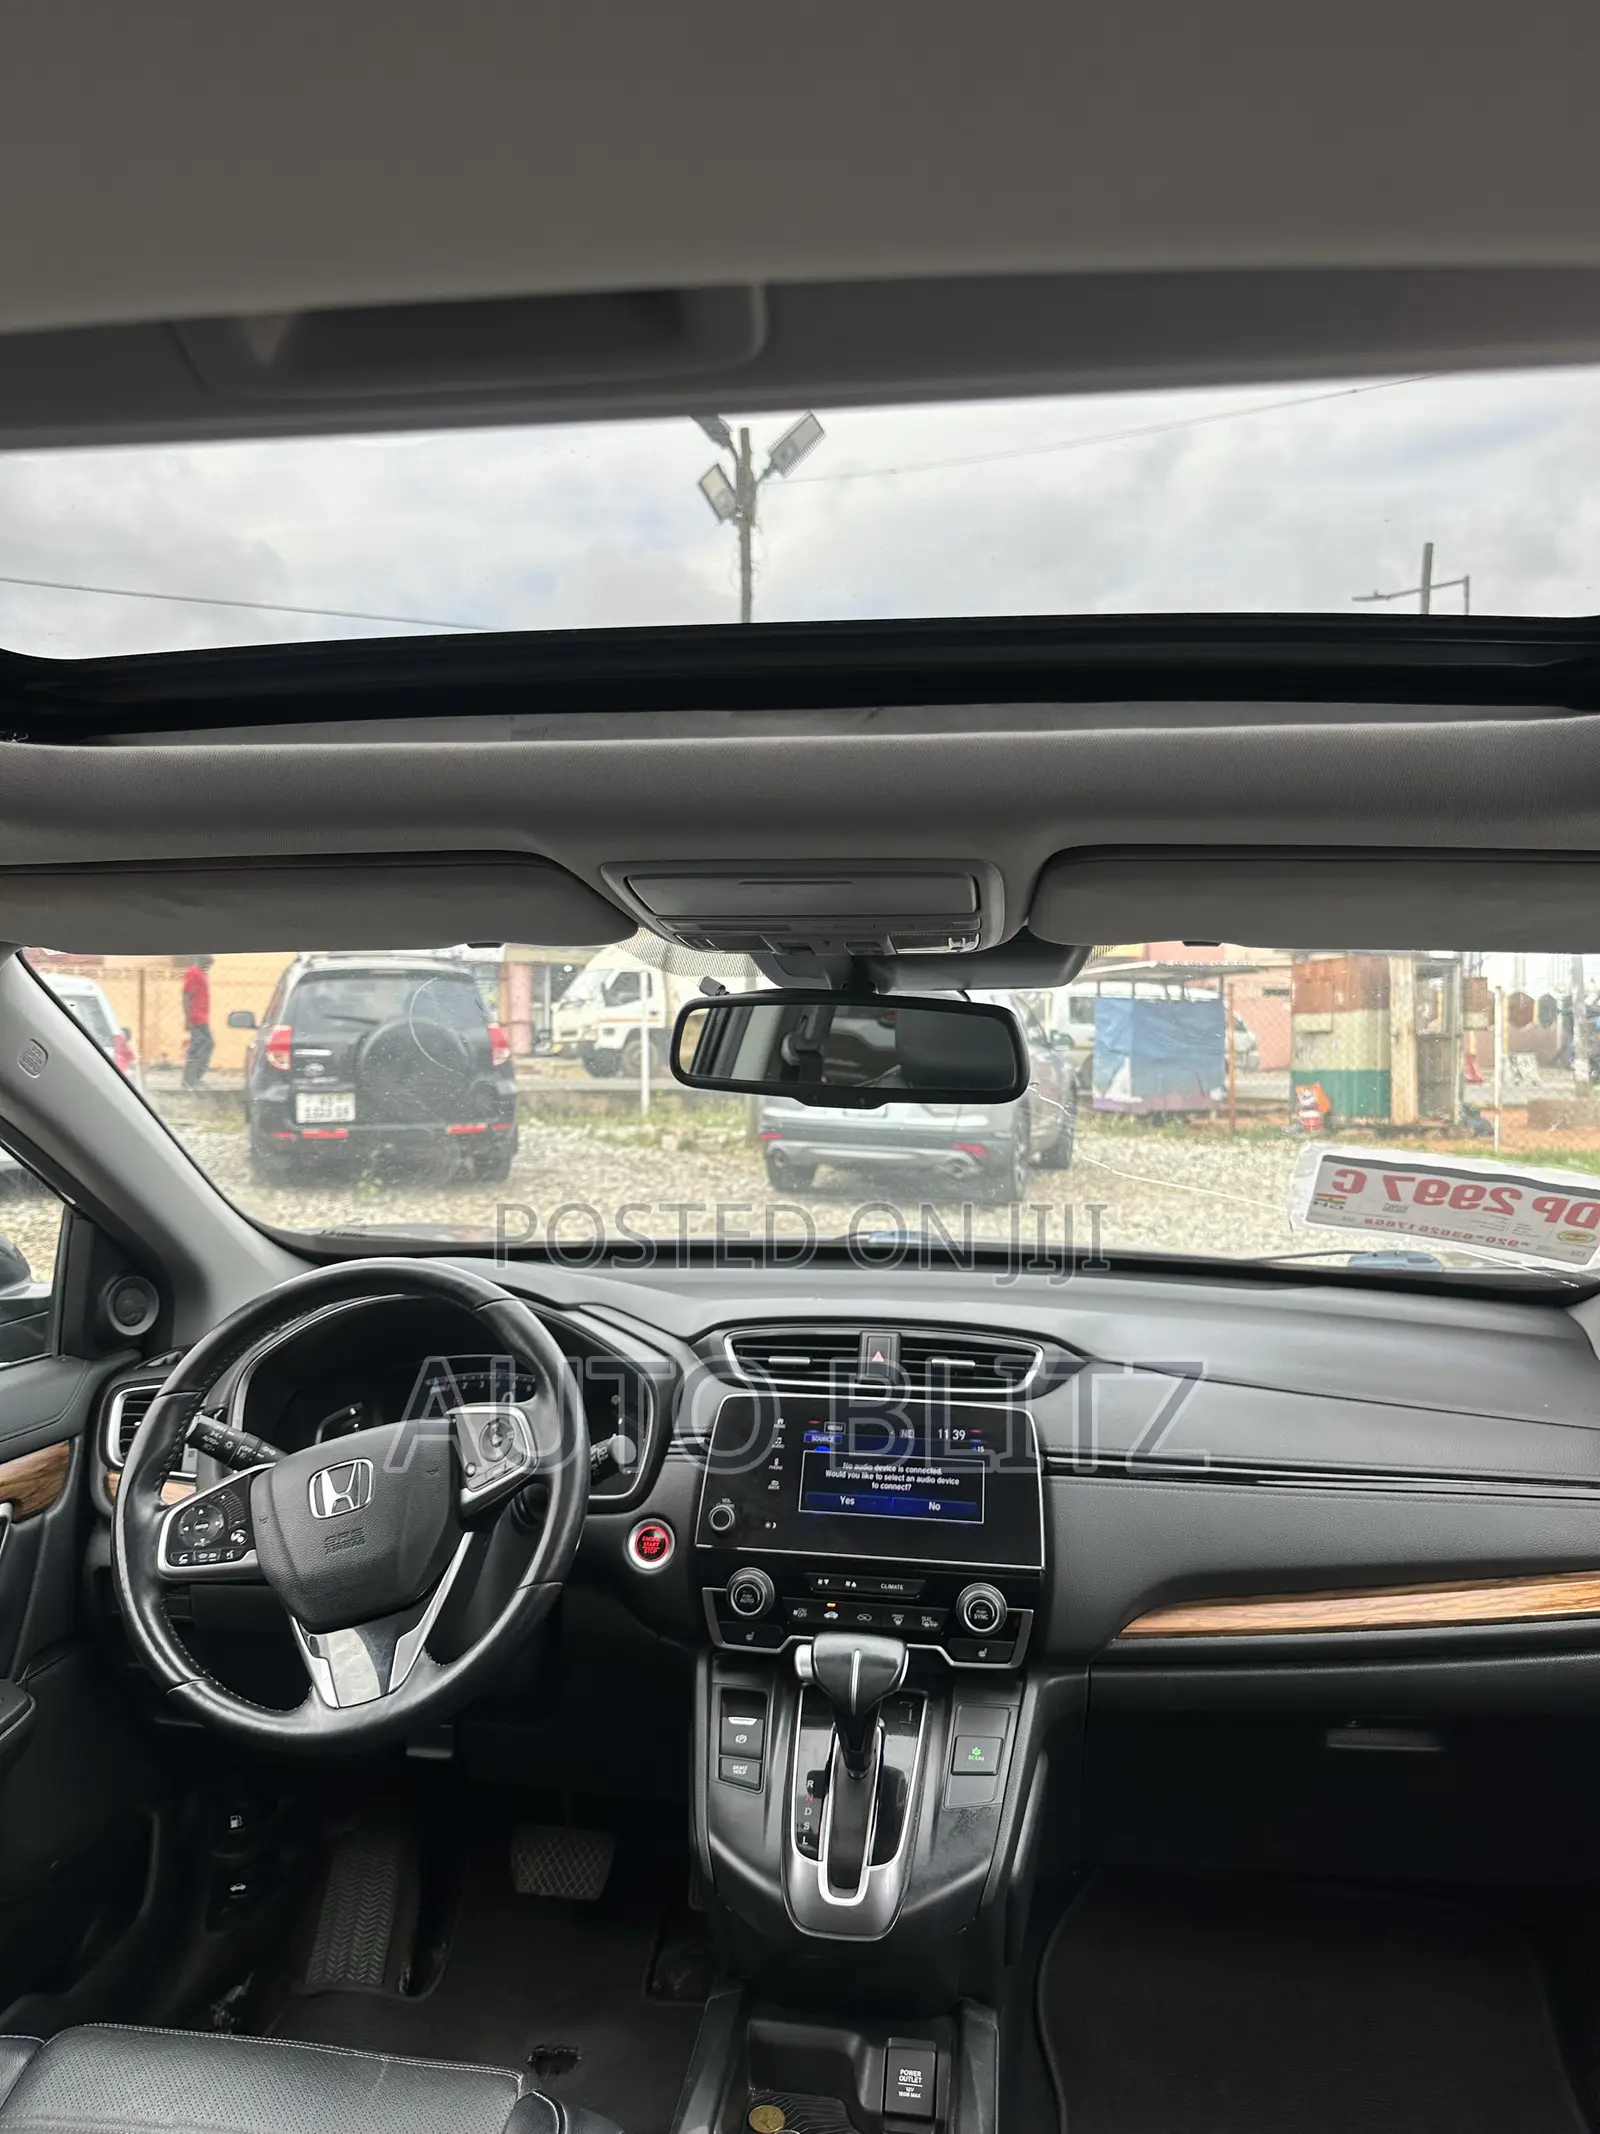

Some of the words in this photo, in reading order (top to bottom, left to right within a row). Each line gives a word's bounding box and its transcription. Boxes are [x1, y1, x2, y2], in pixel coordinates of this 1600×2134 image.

[842, 1461, 853, 1470] No
[854, 1463, 873, 1471] audio
[874, 1464, 897, 1473] device
[898, 1465, 905, 1473] is
[825, 1469, 847, 1479] Would
[847, 1472, 861, 1480] you
[861, 1472, 875, 1480] like
[875, 1473, 883, 1481] to
[884, 1474, 905, 1483] select
[905, 1475, 915, 1483] an
[916, 1475, 936, 1484] audio
[936, 1477, 960, 1485] device
[871, 1481, 880, 1490] to
[880, 1483, 912, 1492] connect?
[840, 1495, 855, 1506] Yes
[928, 1501, 941, 1512] No
[880, 1583, 904, 1591] CLIMATE
[806, 1779, 814, 1788] R
[804, 1806, 812, 1816] D
[803, 1821, 811, 1831] S
[802, 1835, 809, 1845] L
[900, 2069, 922, 2077] POWER
[898, 2075, 922, 2083] OUTLET
